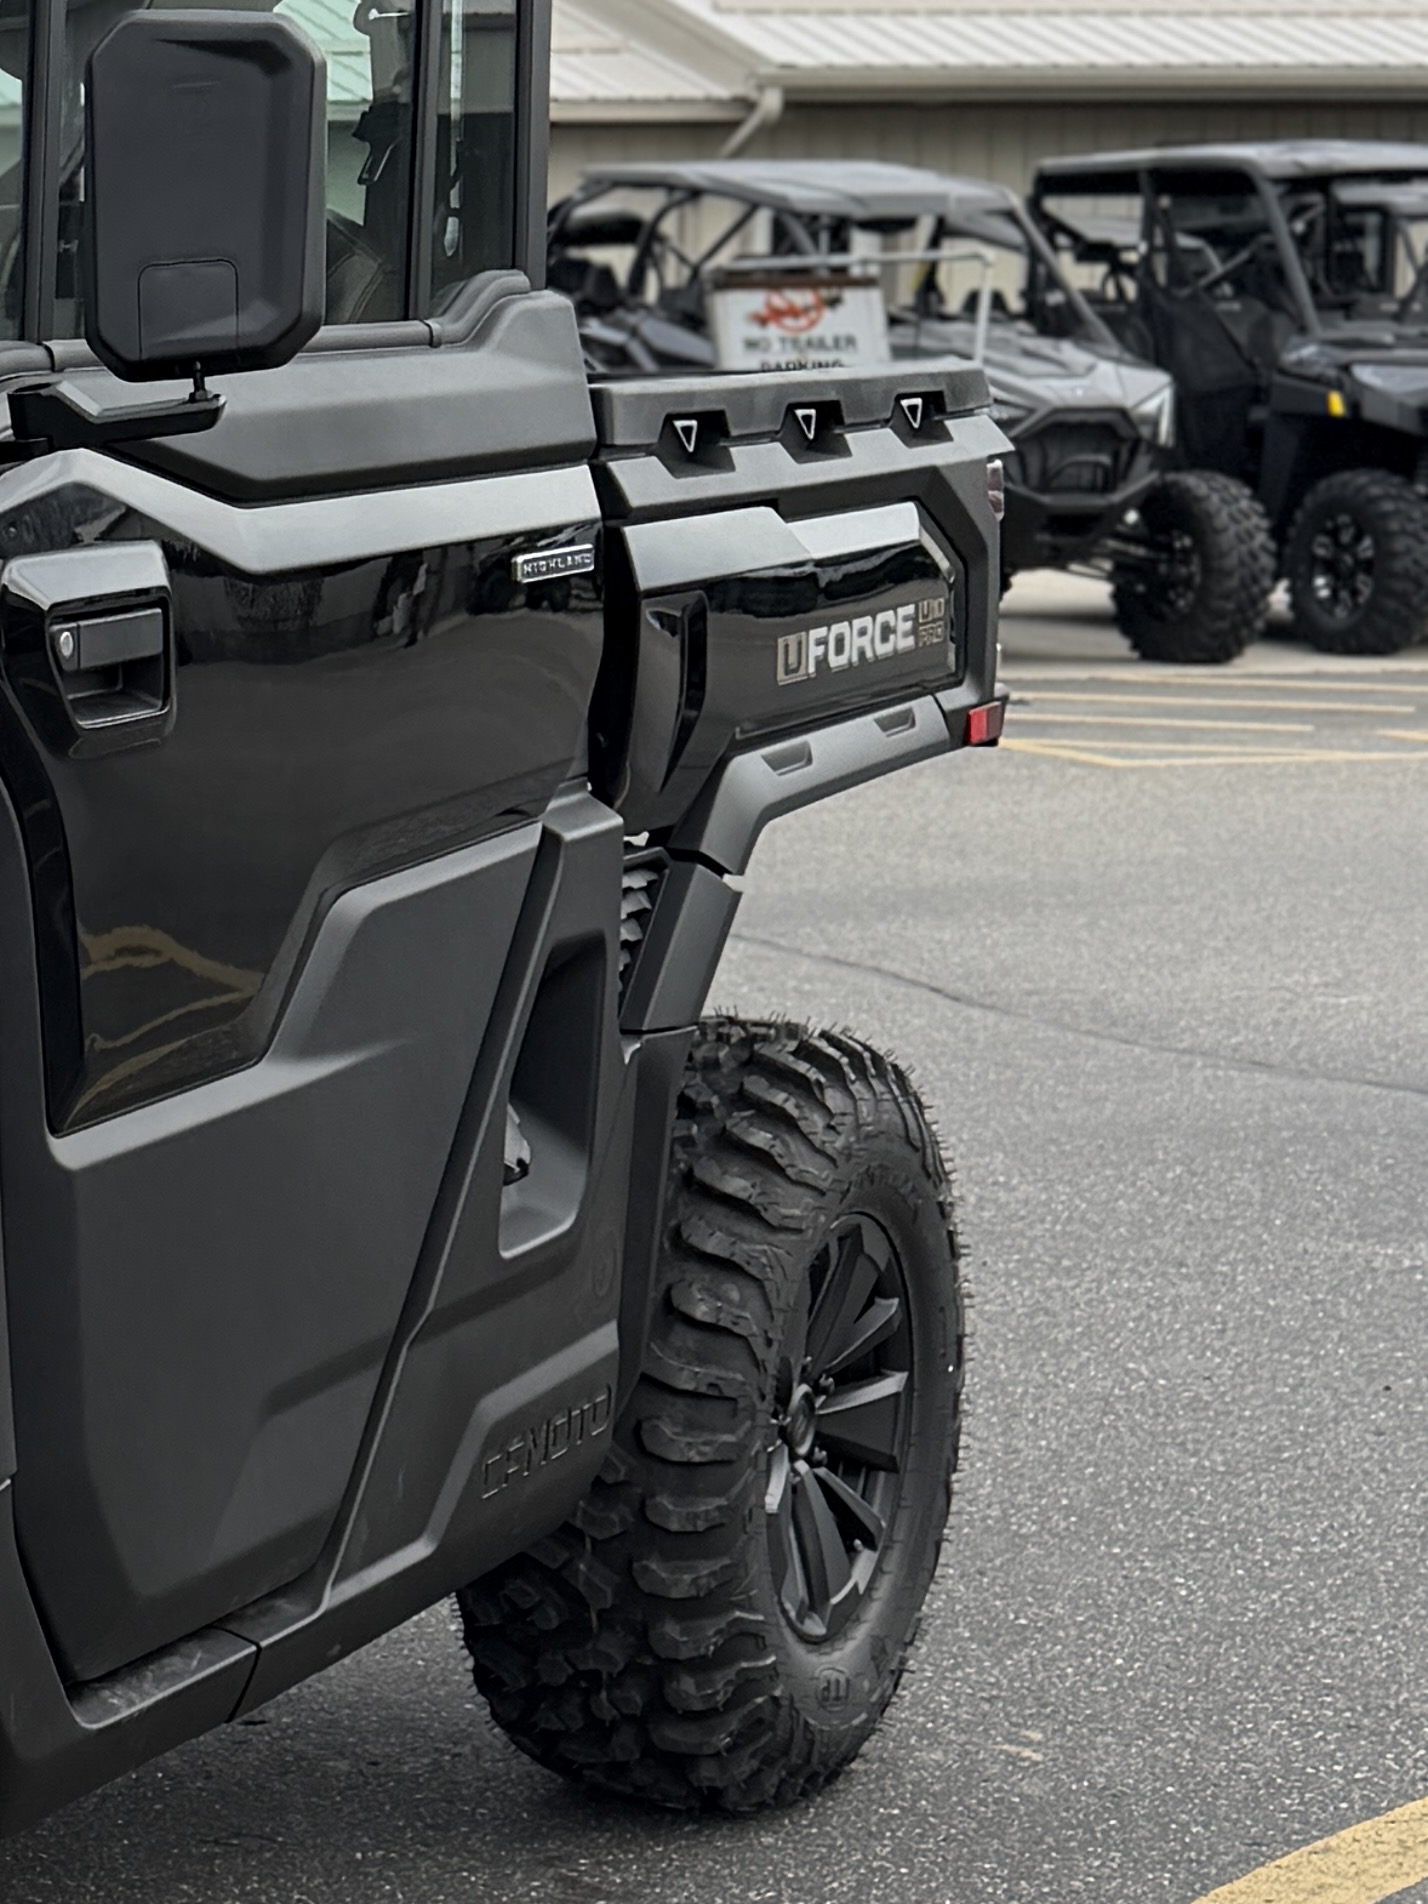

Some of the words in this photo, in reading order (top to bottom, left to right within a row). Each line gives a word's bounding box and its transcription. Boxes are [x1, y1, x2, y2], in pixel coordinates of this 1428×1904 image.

[744, 335, 772, 352] NO
[778, 334, 857, 352] TRAILER
[523, 552, 591, 574] HIGHLAND
[482, 1383, 612, 1499] CFMOTO
